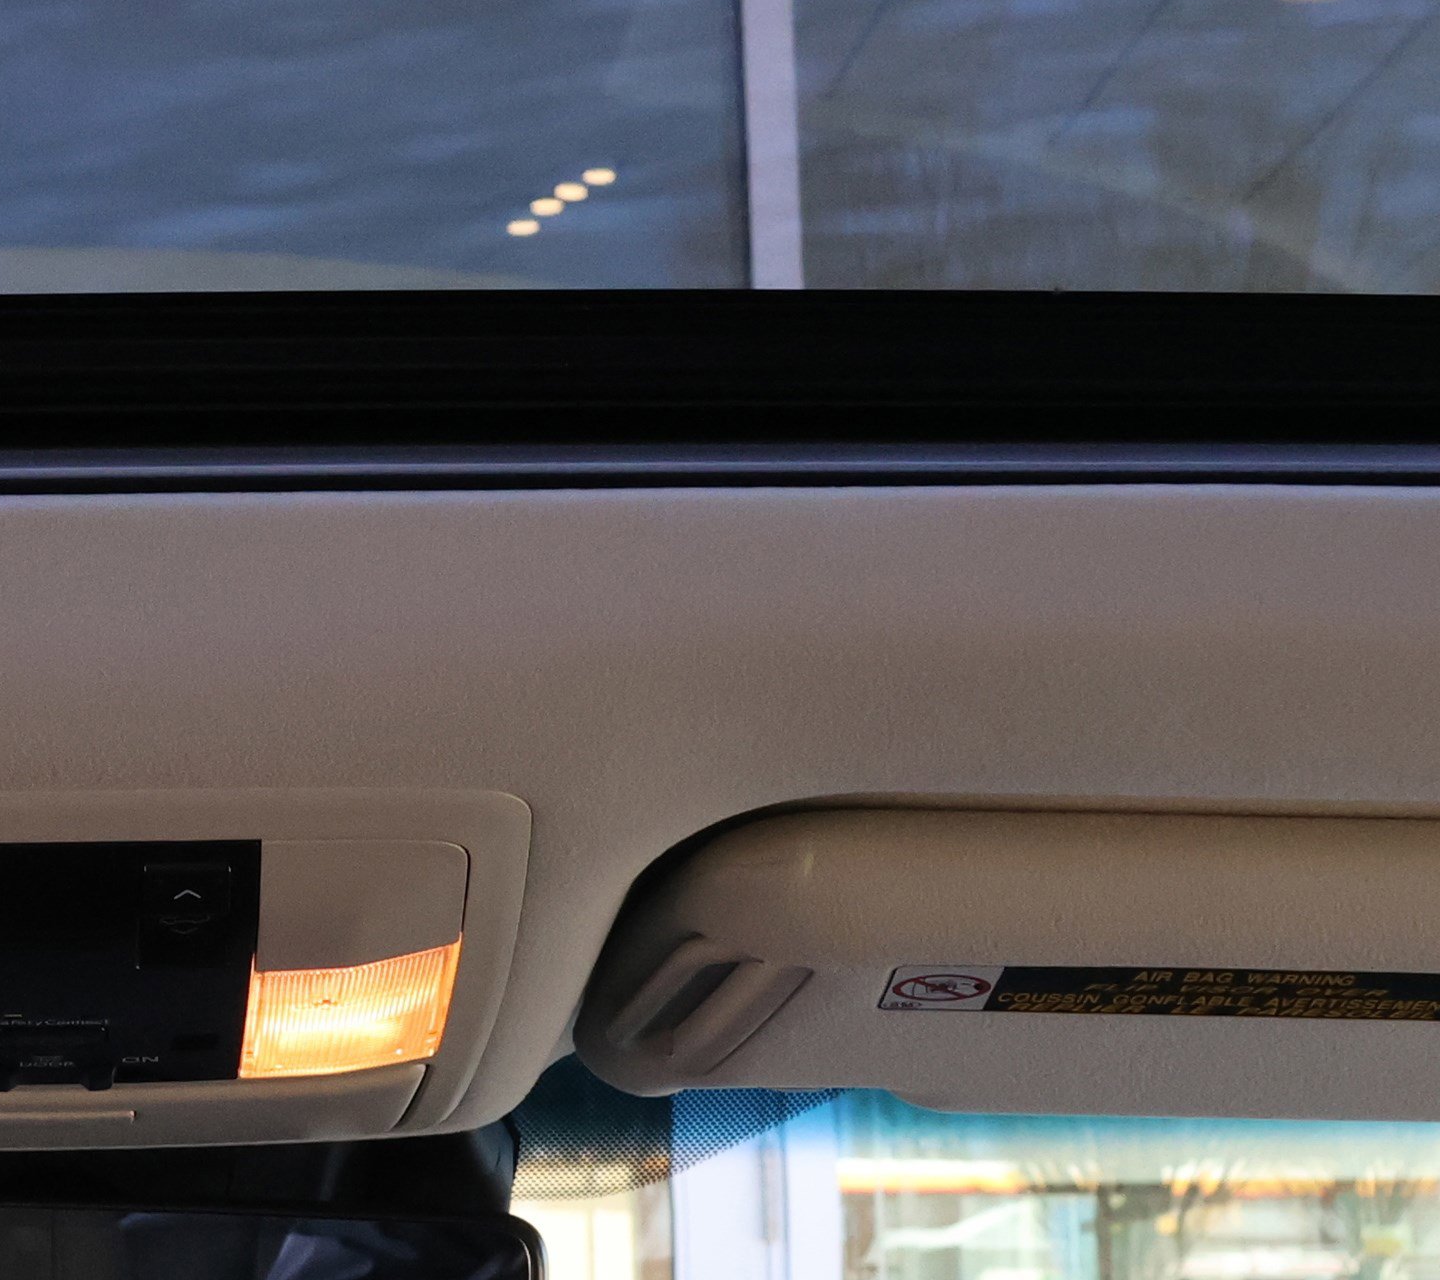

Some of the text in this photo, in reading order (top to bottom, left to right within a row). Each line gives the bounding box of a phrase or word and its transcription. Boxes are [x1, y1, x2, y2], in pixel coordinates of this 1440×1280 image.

[1134, 970, 1357, 986] AIR BAG WARNING
[998, 992, 1102, 1004] COUSSIN
[121, 1055, 160, 1064] ON
